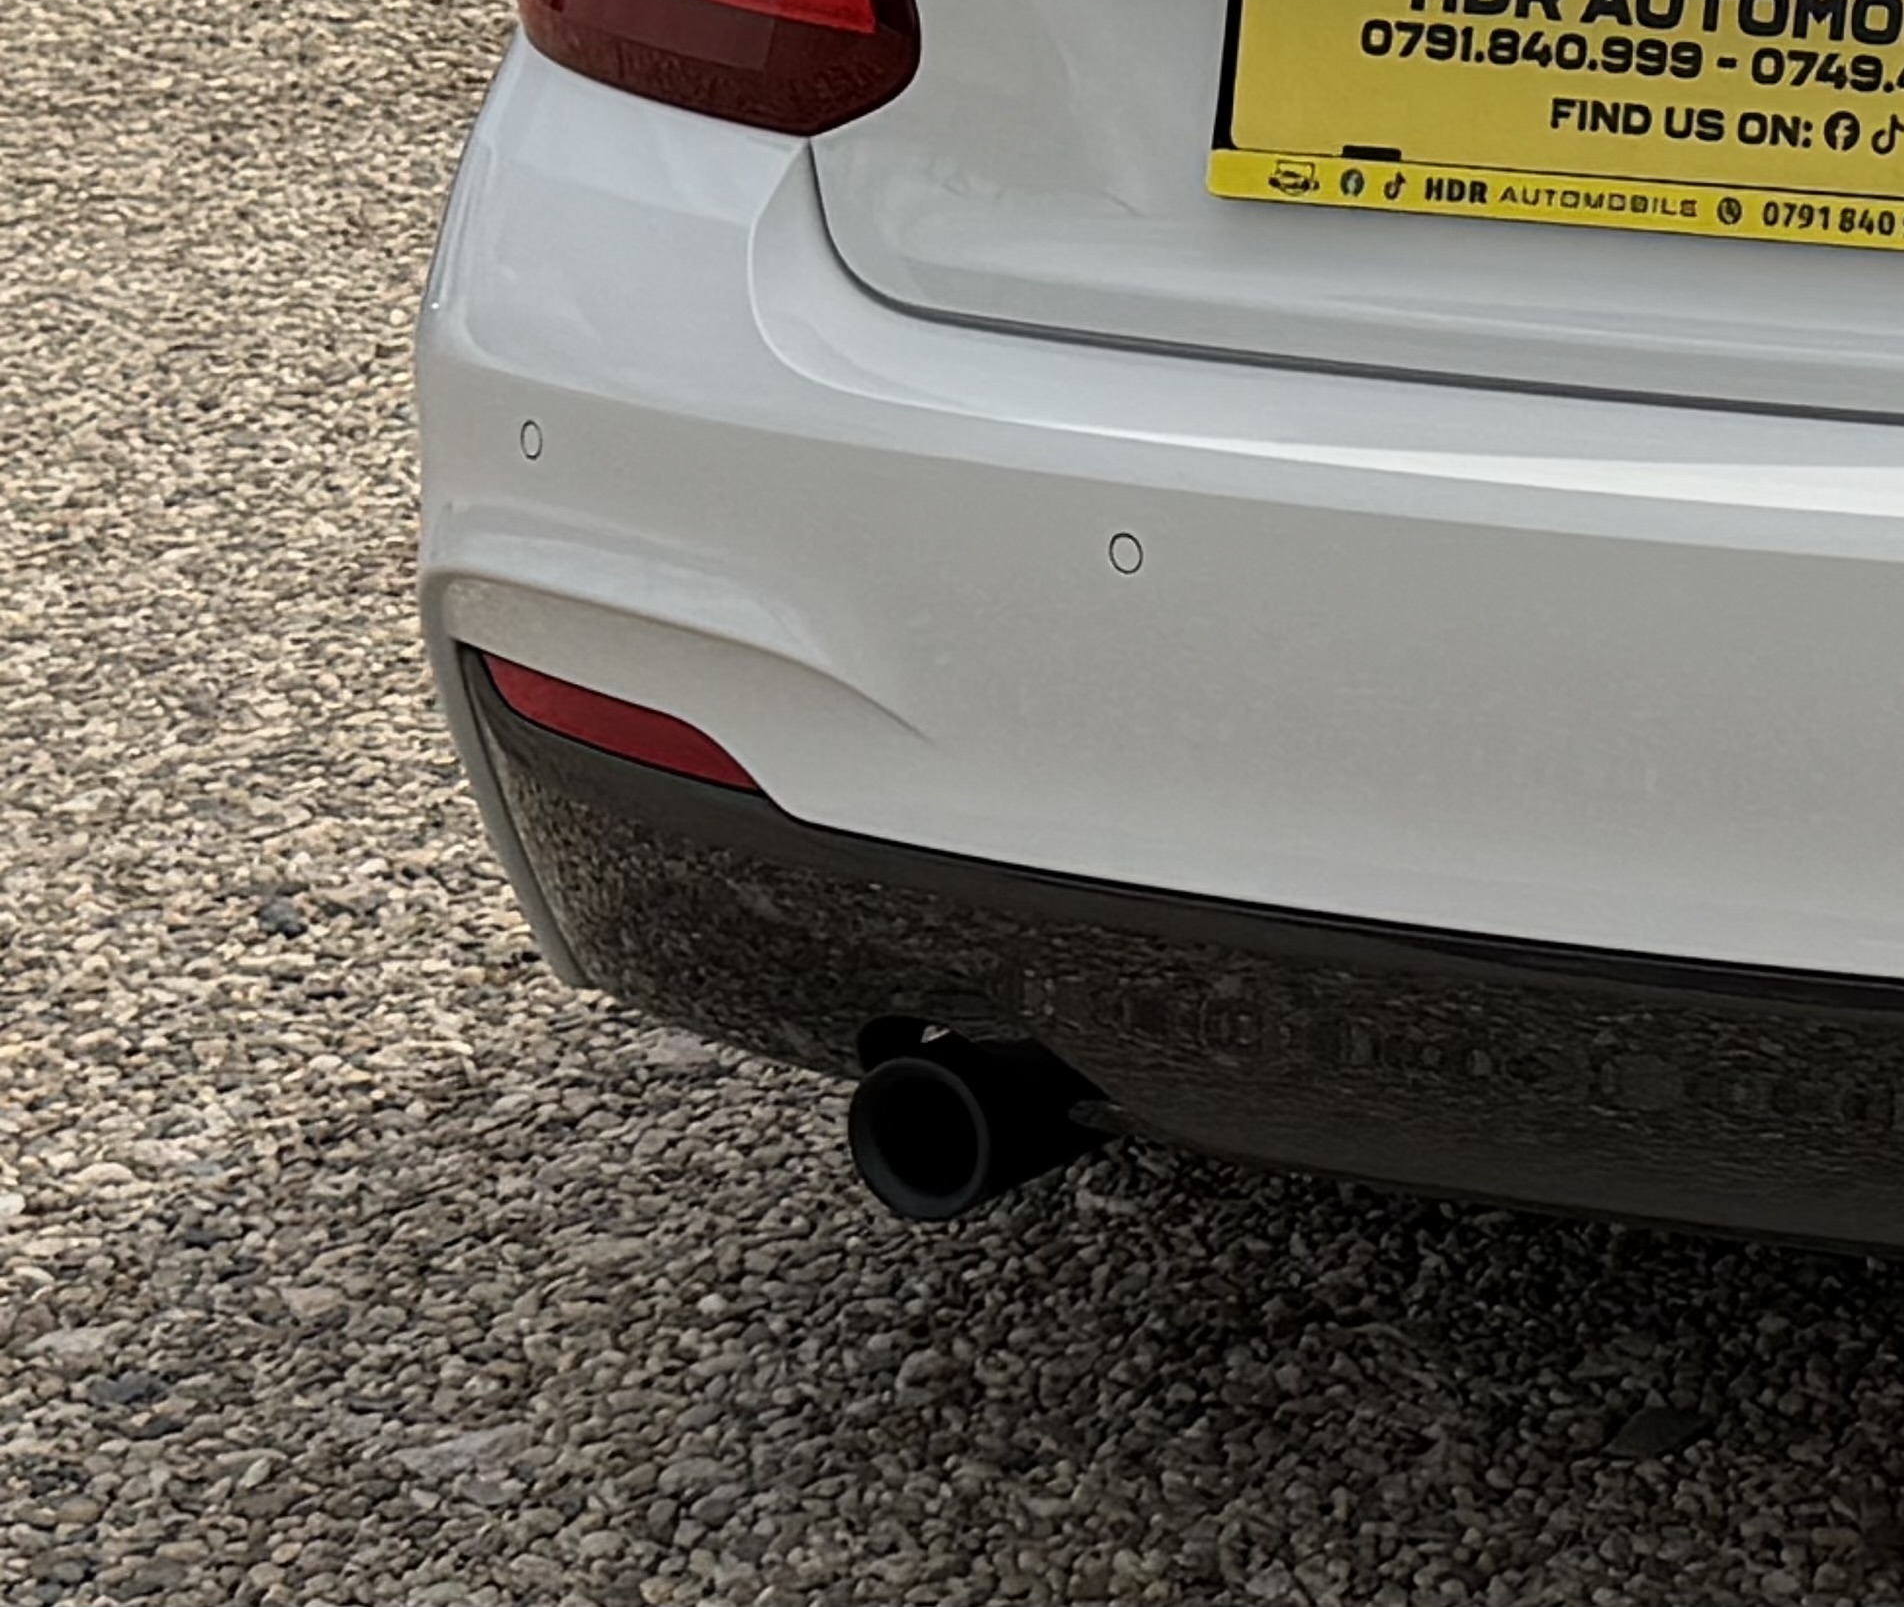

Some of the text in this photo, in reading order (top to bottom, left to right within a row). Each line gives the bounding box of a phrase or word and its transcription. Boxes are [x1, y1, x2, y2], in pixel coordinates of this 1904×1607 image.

[1360, 18, 1703, 79] 0791.840.999
[1549, 97, 1814, 149] FIND US ON:
[1424, 176, 1488, 204] HDR
[1498, 186, 1699, 218] AUTOMOBILE
[1761, 200, 1831, 231] 0791
[1838, 205, 1895, 236] 840
